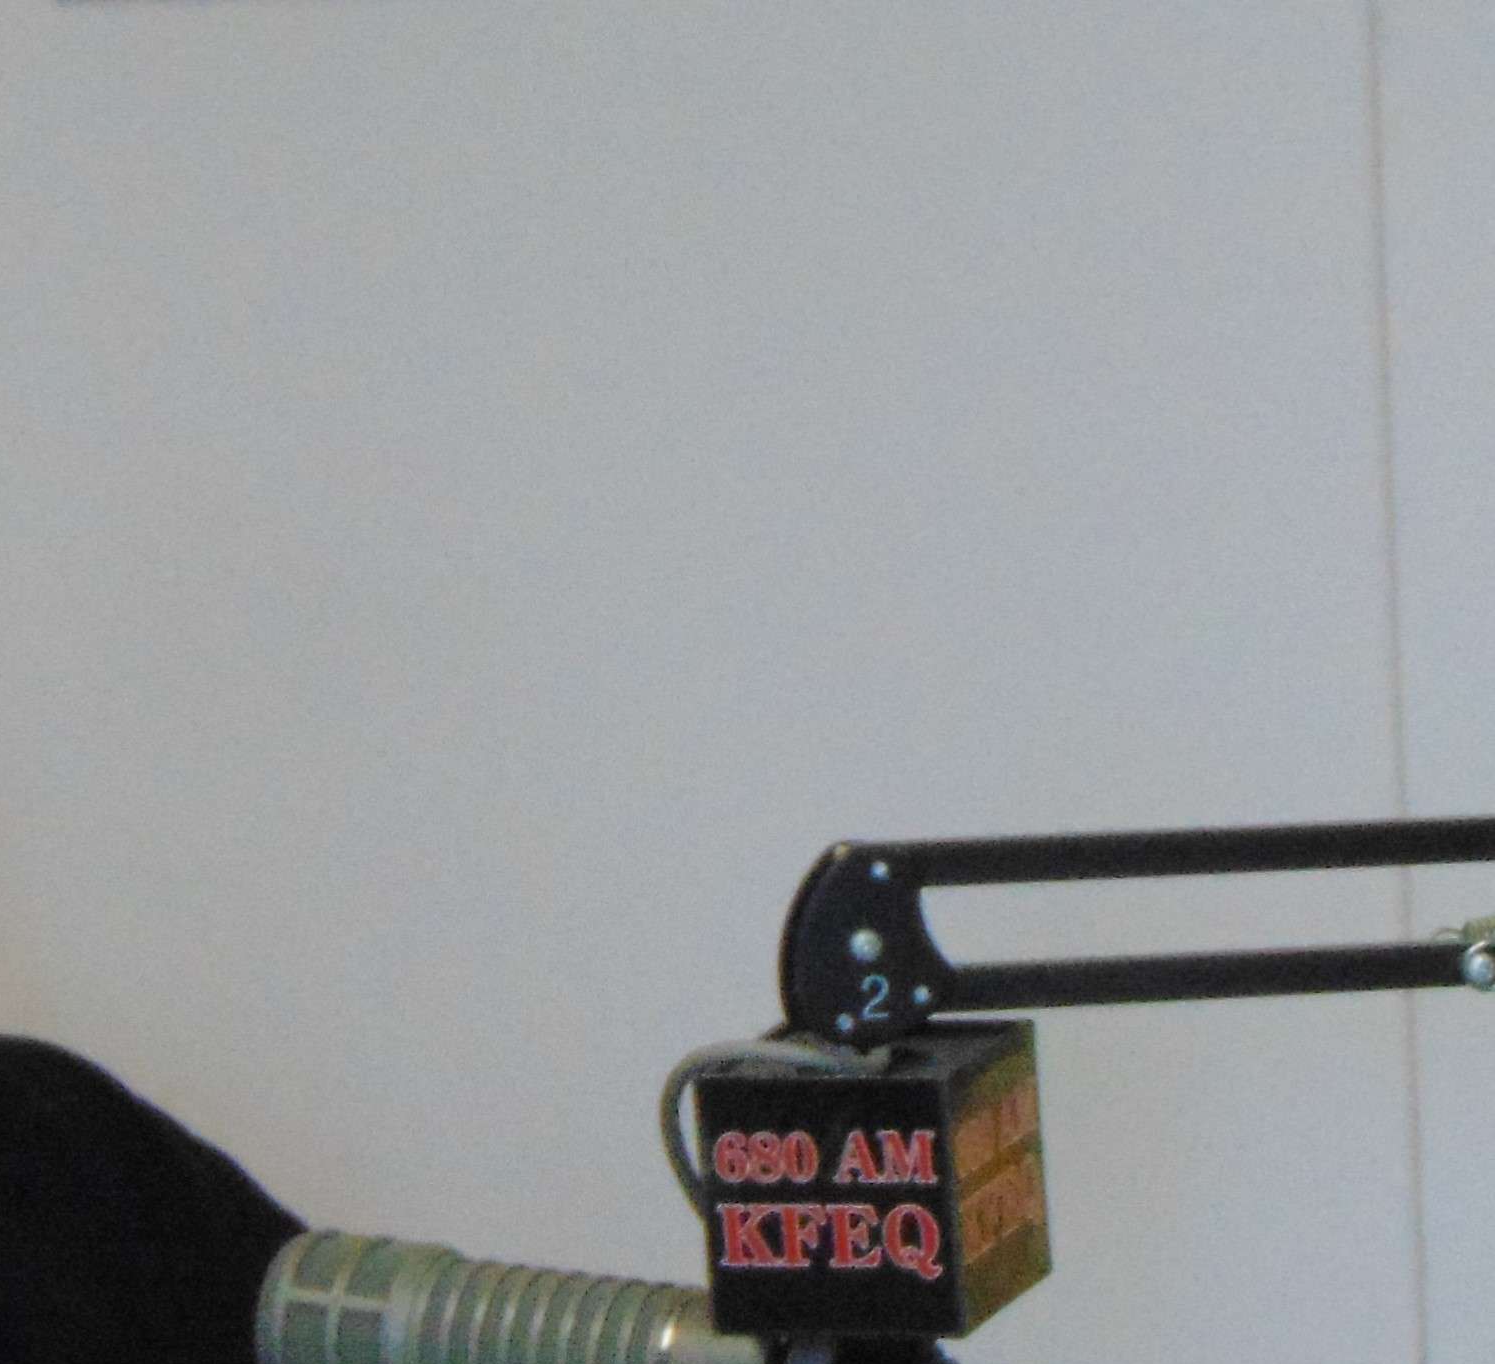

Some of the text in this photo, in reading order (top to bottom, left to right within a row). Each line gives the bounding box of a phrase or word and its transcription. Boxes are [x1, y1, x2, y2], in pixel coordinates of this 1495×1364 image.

[860, 973, 890, 1021] 2
[713, 1128, 938, 1185] 680 AM
[716, 1203, 944, 1280] KFEQ
